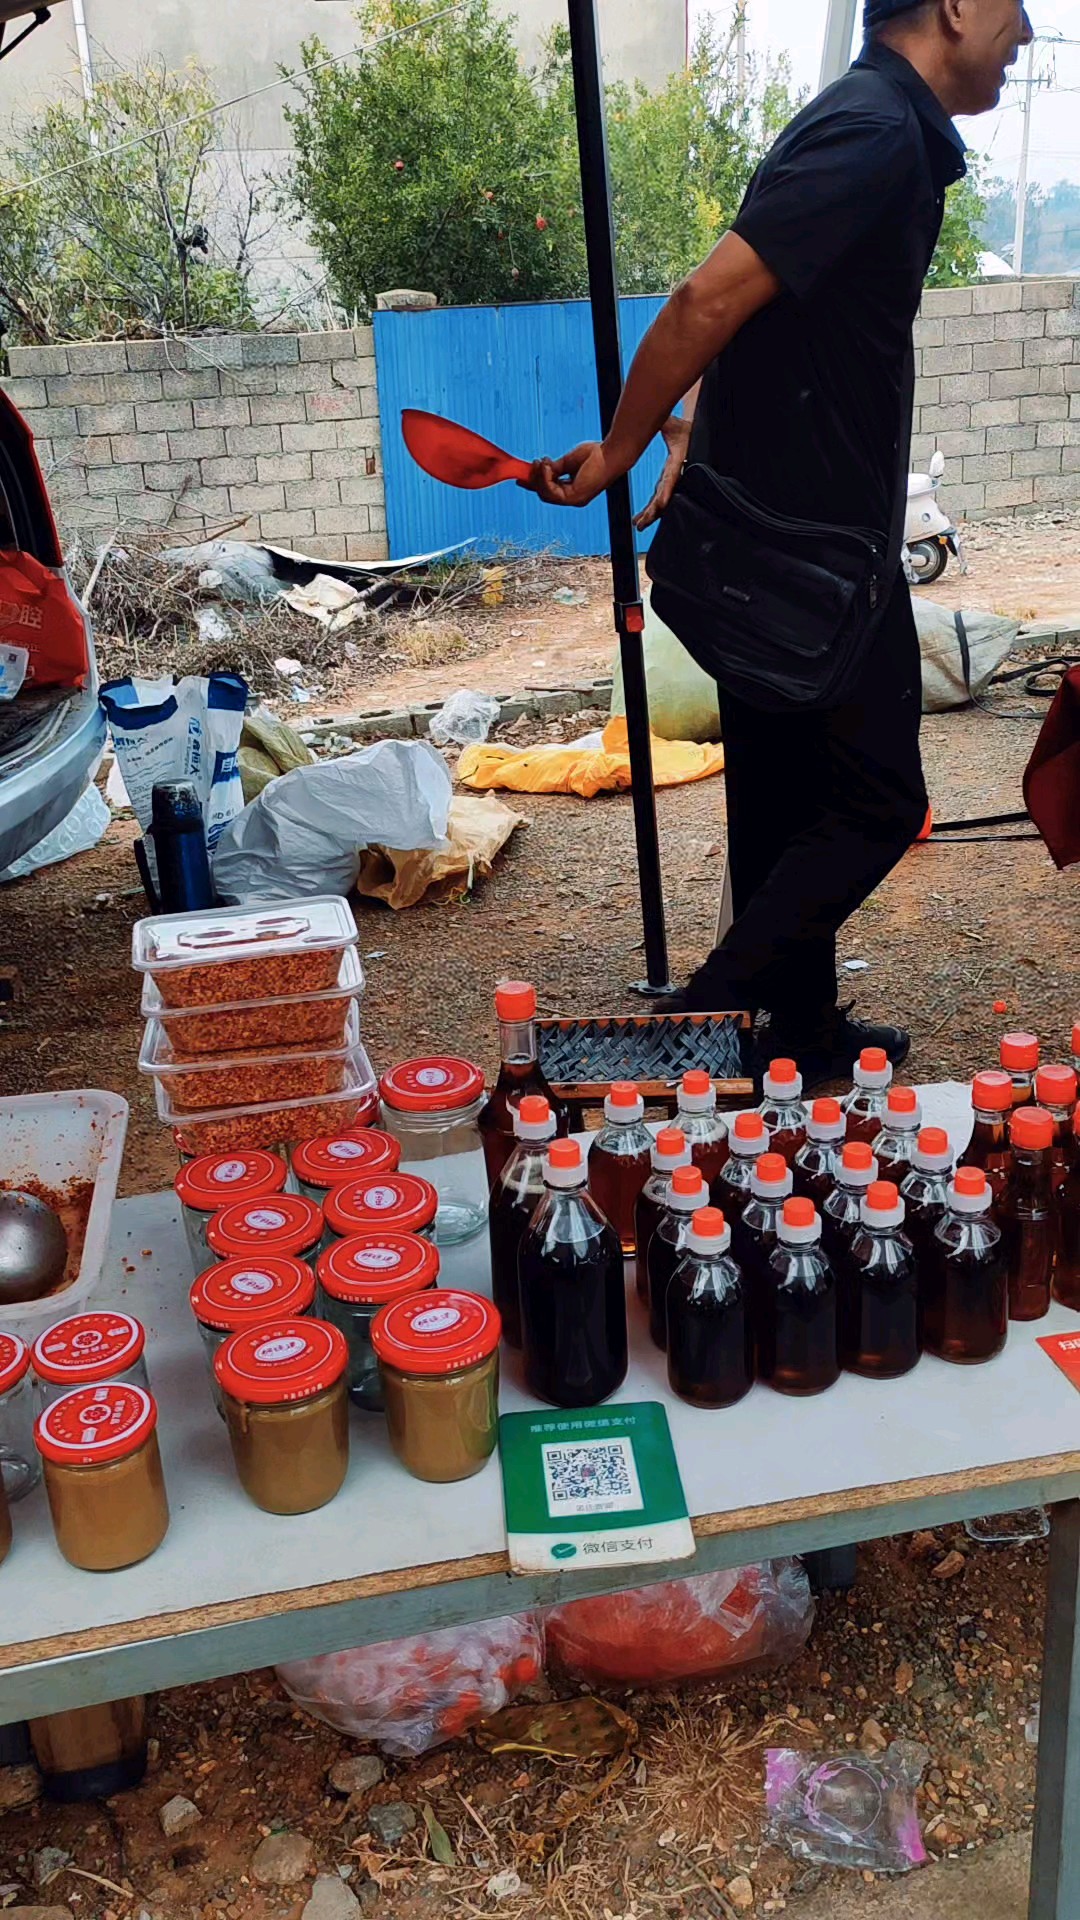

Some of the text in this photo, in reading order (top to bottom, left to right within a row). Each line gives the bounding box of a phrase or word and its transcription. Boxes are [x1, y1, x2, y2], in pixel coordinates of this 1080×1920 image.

[530, 1415, 637, 1433] 推荐使用微信支付
[583, 1536, 654, 1555] 微信支付
